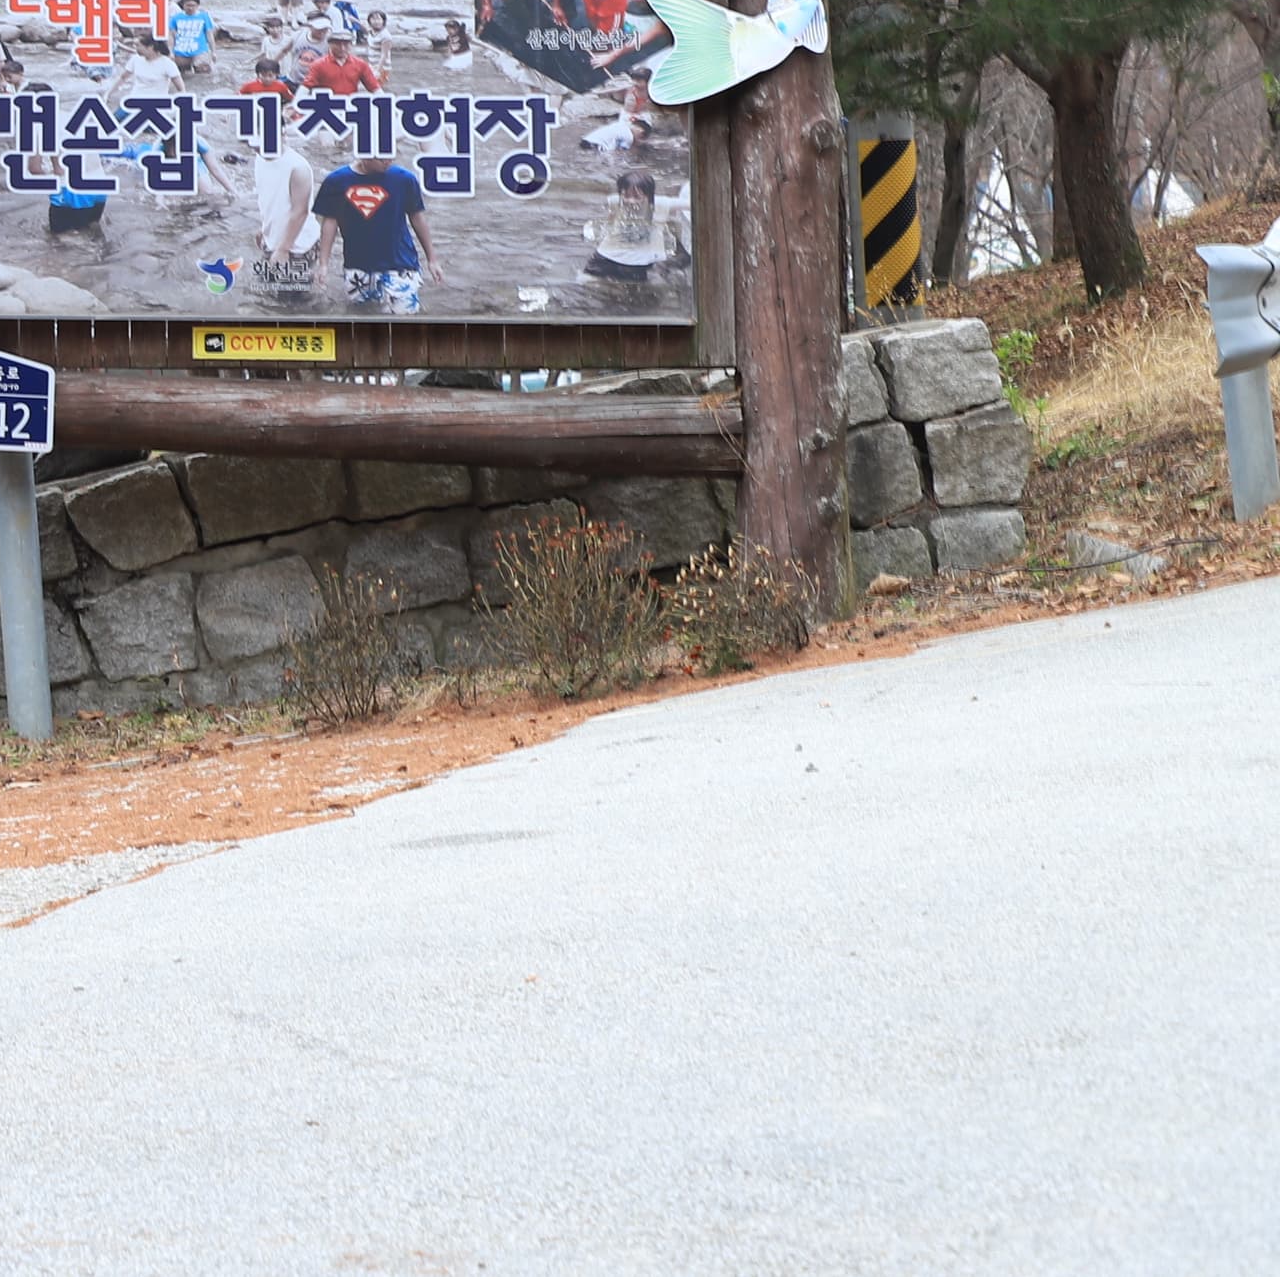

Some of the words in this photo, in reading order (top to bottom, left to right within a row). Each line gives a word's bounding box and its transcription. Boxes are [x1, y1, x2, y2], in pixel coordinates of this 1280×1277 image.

[296, 90, 558, 196] 체험장
[230, 335, 278, 351] CCTV
[281, 335, 324, 353] 작동중
